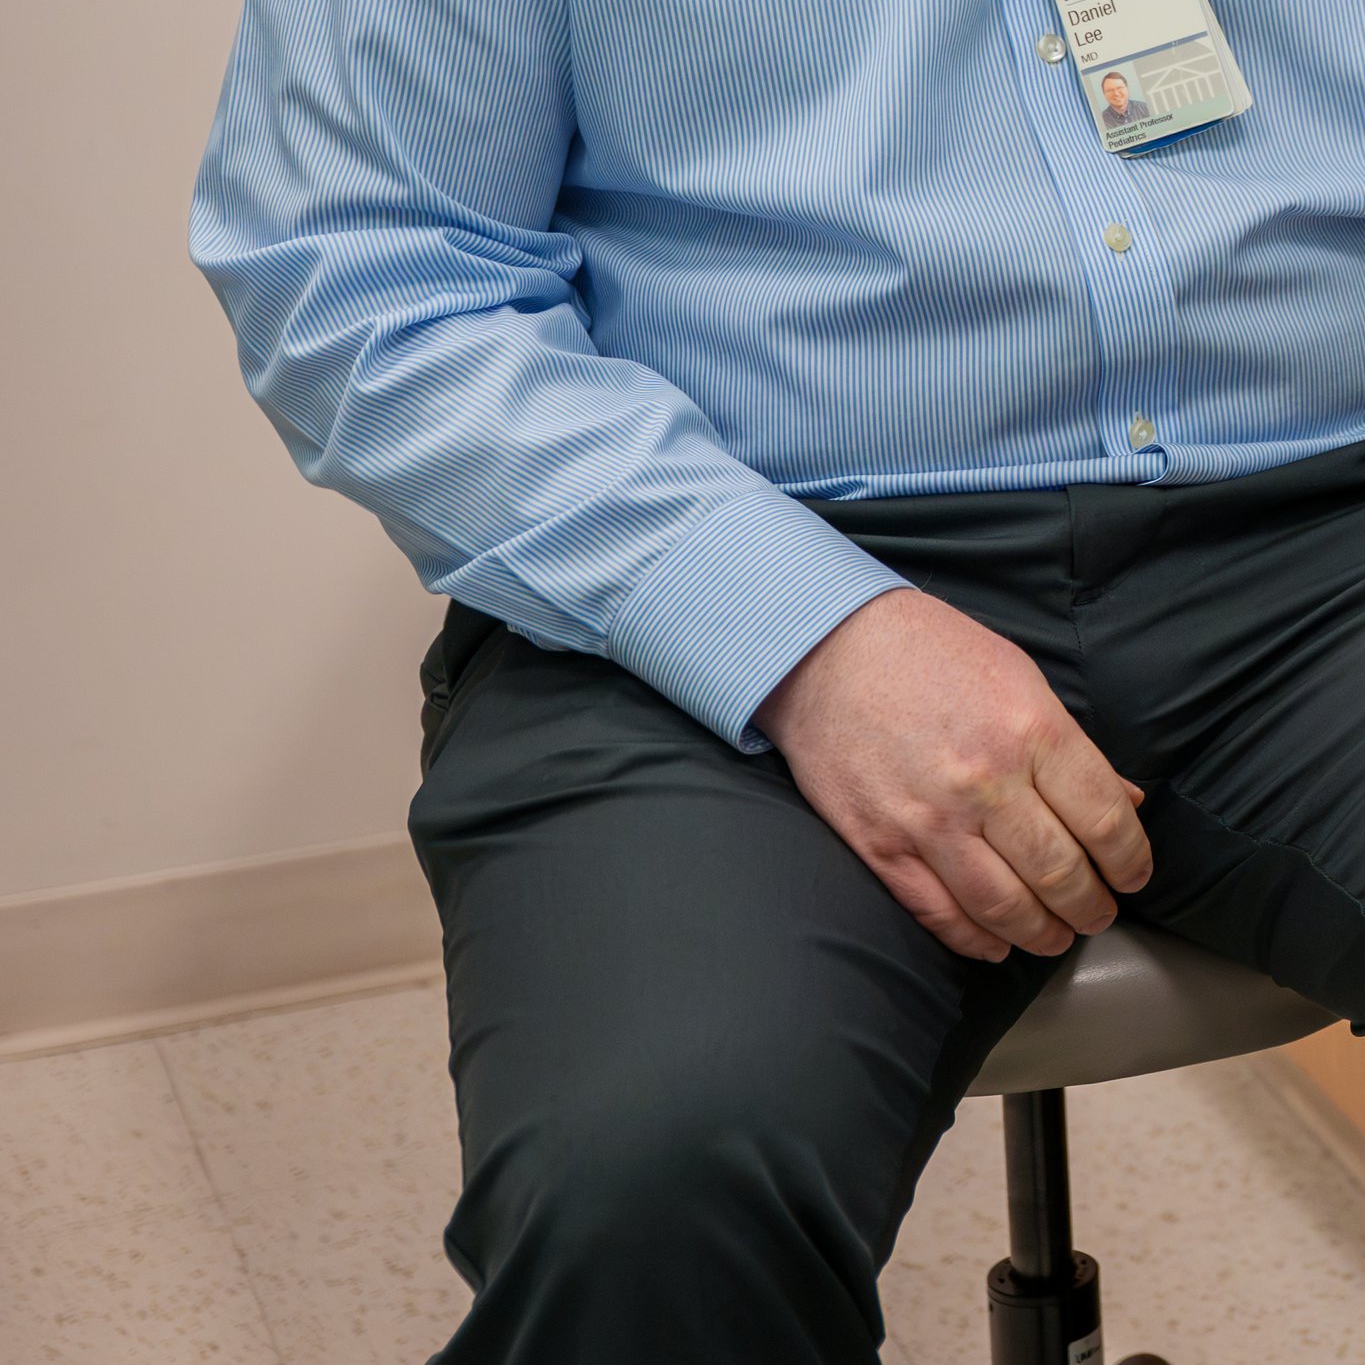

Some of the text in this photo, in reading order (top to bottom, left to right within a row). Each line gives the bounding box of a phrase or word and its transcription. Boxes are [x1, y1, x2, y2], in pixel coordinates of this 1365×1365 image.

[1074, 28, 1103, 47] Lee
[1081, 51, 1098, 64] MD
[1106, 113, 1174, 140] Assistant Professor
[1108, 132, 1147, 149] Pediatrics
